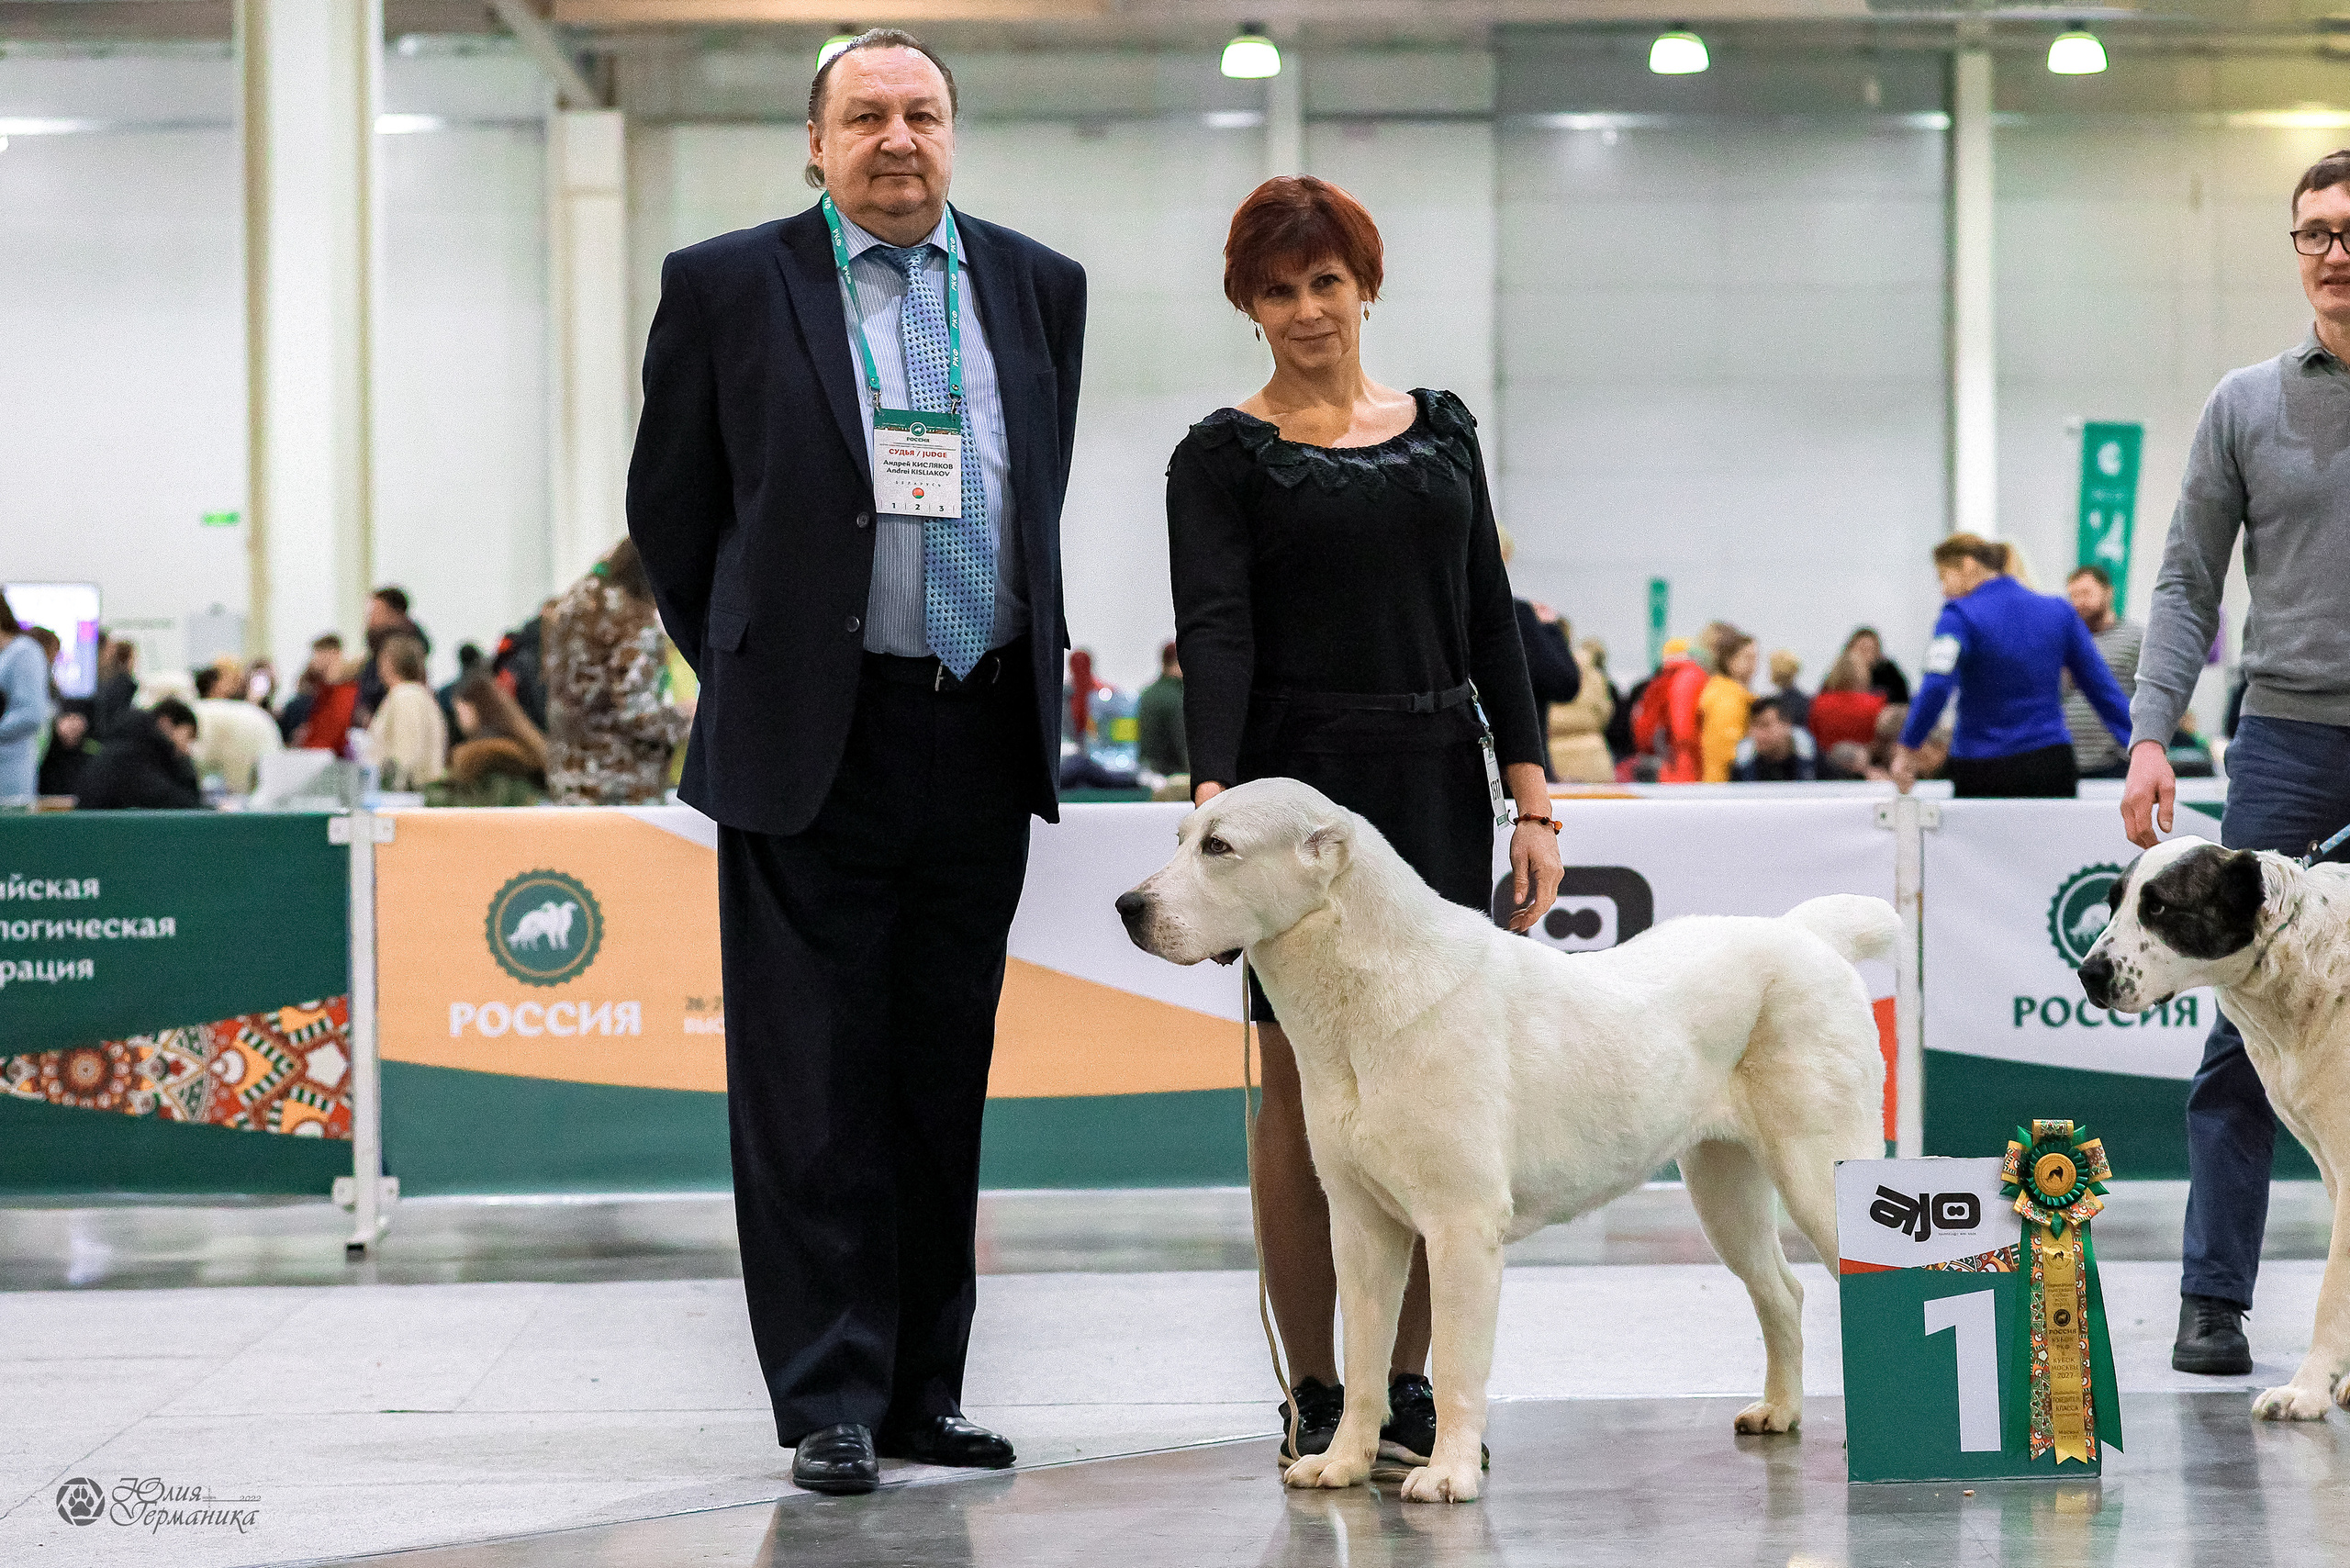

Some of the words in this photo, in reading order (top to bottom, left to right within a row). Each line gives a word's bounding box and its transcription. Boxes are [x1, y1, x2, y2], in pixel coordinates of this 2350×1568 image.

[832, 228, 842, 247] РКФ
[950, 273, 958, 292] РКФ
[889, 448, 914, 457] СУДЬЯ
[883, 459, 911, 467] Андрей
[912, 461, 954, 470] КИСЛЯКОВ
[911, 469, 950, 477] KISLIAKOV
[449, 1000, 642, 1037] РОССИЯ
[1923, 1289, 2002, 1451] 1
